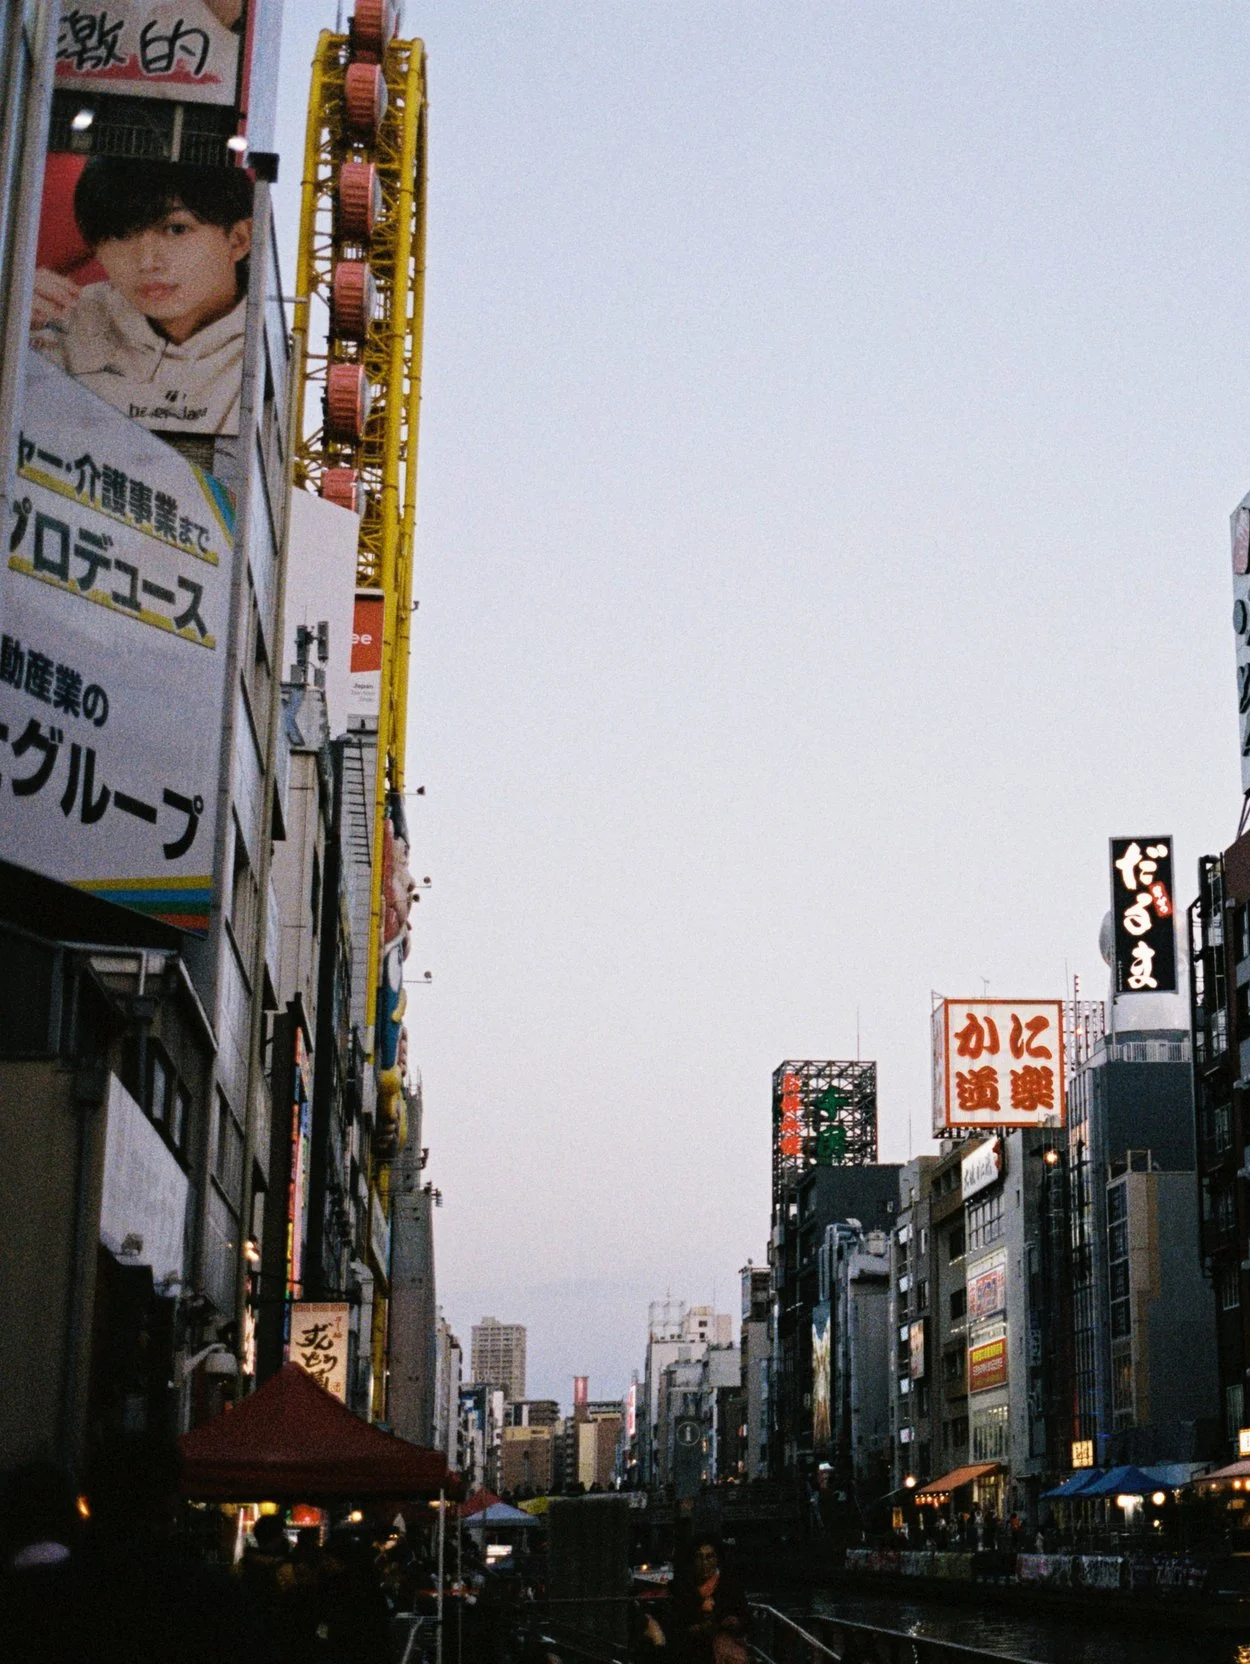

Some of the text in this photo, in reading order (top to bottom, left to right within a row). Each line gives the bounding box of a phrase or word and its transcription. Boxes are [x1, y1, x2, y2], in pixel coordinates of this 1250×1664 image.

[1115, 842, 1168, 989] だるま
[954, 1012, 1052, 1060] かに
